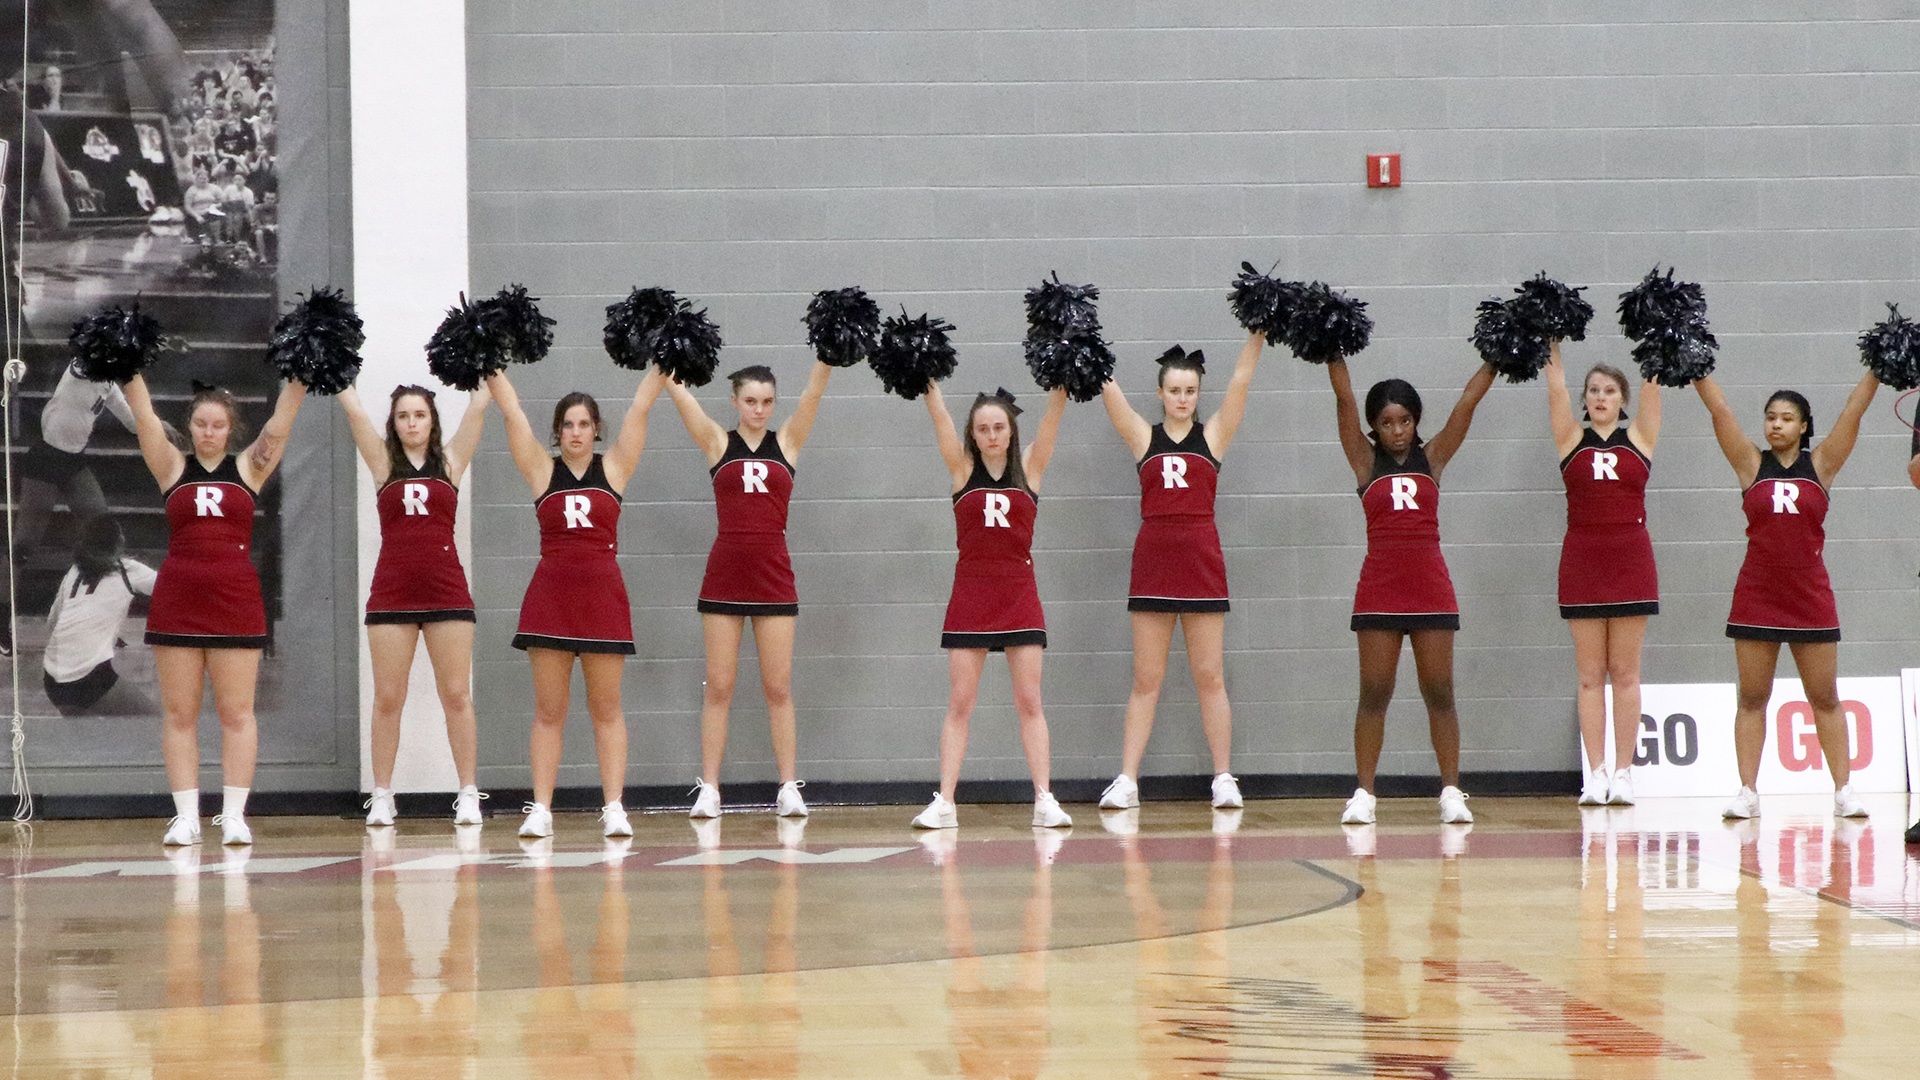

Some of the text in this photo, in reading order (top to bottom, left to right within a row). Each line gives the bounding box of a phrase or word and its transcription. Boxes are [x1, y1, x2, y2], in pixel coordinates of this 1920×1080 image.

[742, 461, 769, 493] R
[1162, 455, 1189, 489] R
[1592, 451, 1619, 481] R
[195, 485, 224, 517] R
[402, 483, 429, 516] R
[983, 492, 1011, 528] R
[1391, 476, 1419, 511] R
[1772, 481, 1799, 514] R
[564, 494, 594, 529] R
[1632, 713, 1698, 766] GO
[1776, 700, 1873, 772] GO
